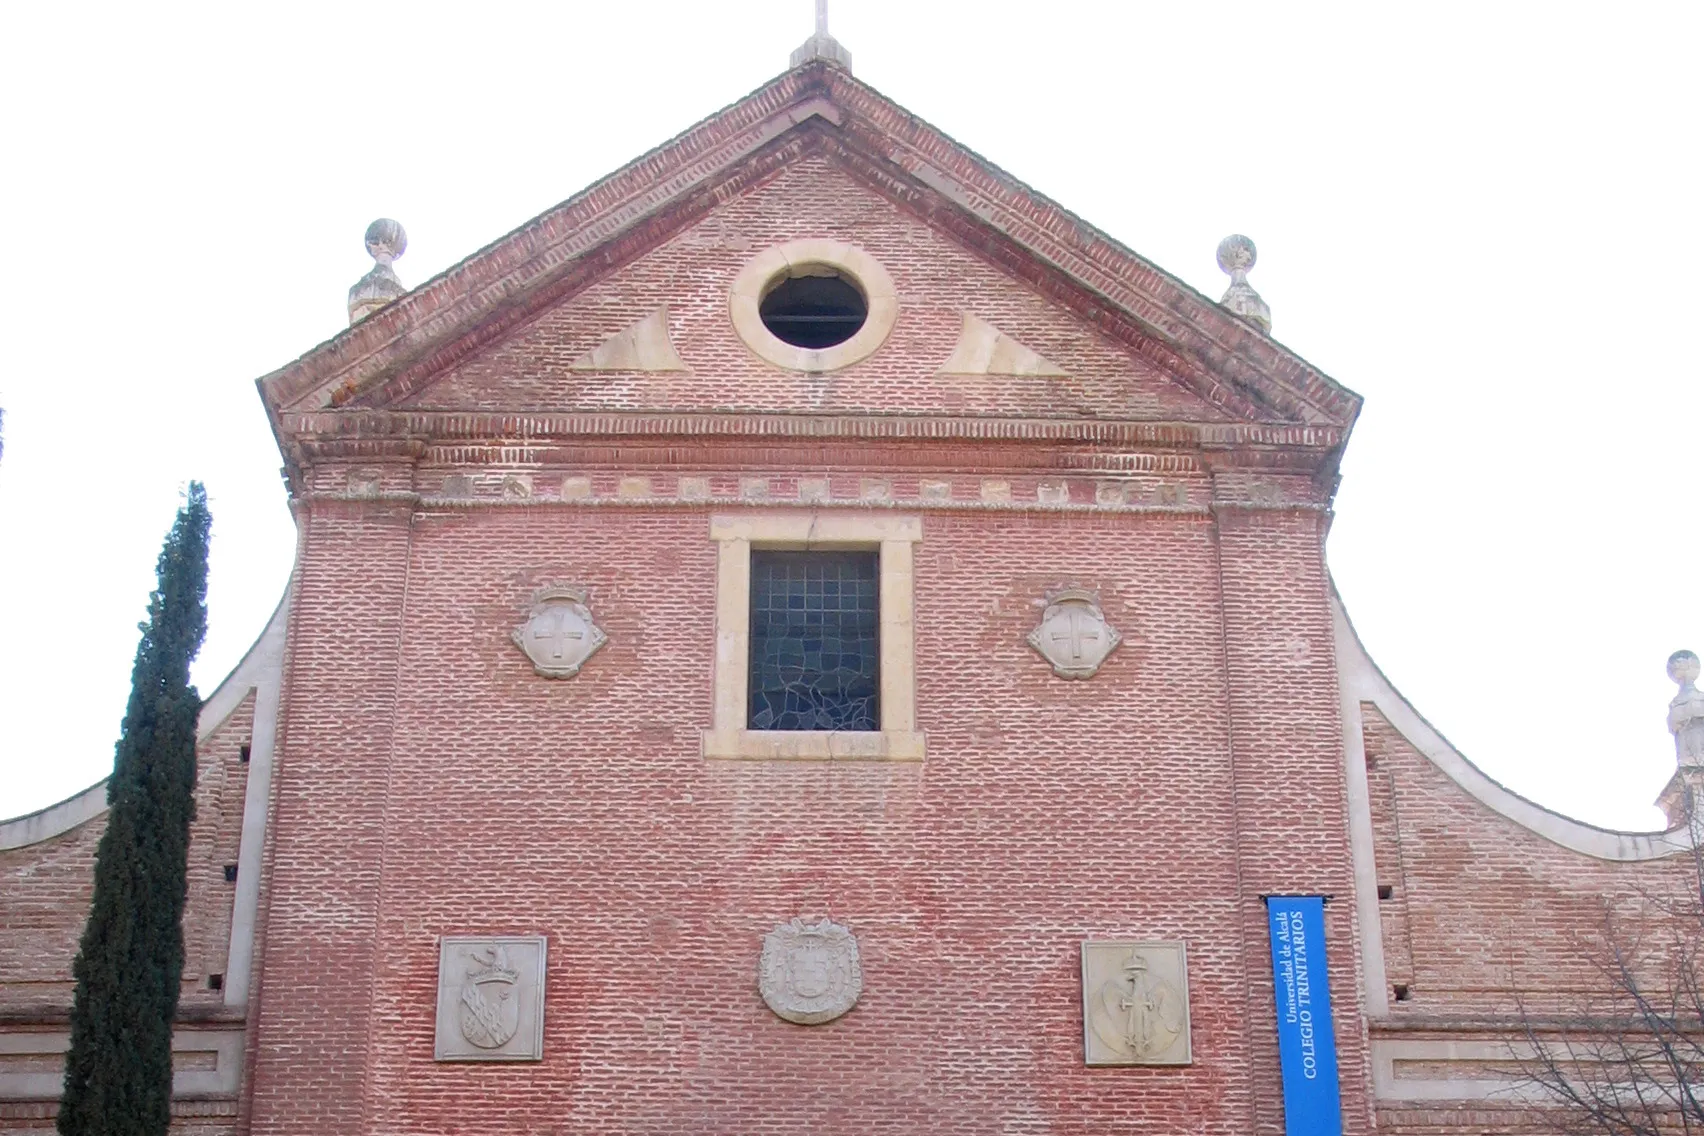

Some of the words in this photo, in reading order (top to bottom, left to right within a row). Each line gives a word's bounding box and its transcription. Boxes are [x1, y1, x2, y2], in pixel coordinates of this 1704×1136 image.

[1275, 911, 1290, 943] Alcalá
[1278, 944, 1291, 957] de
[1290, 911, 1310, 1007] TRINITARIOS
[1280, 959, 1298, 1023] Universidad
[1299, 1010, 1317, 1079] COLEGIO
